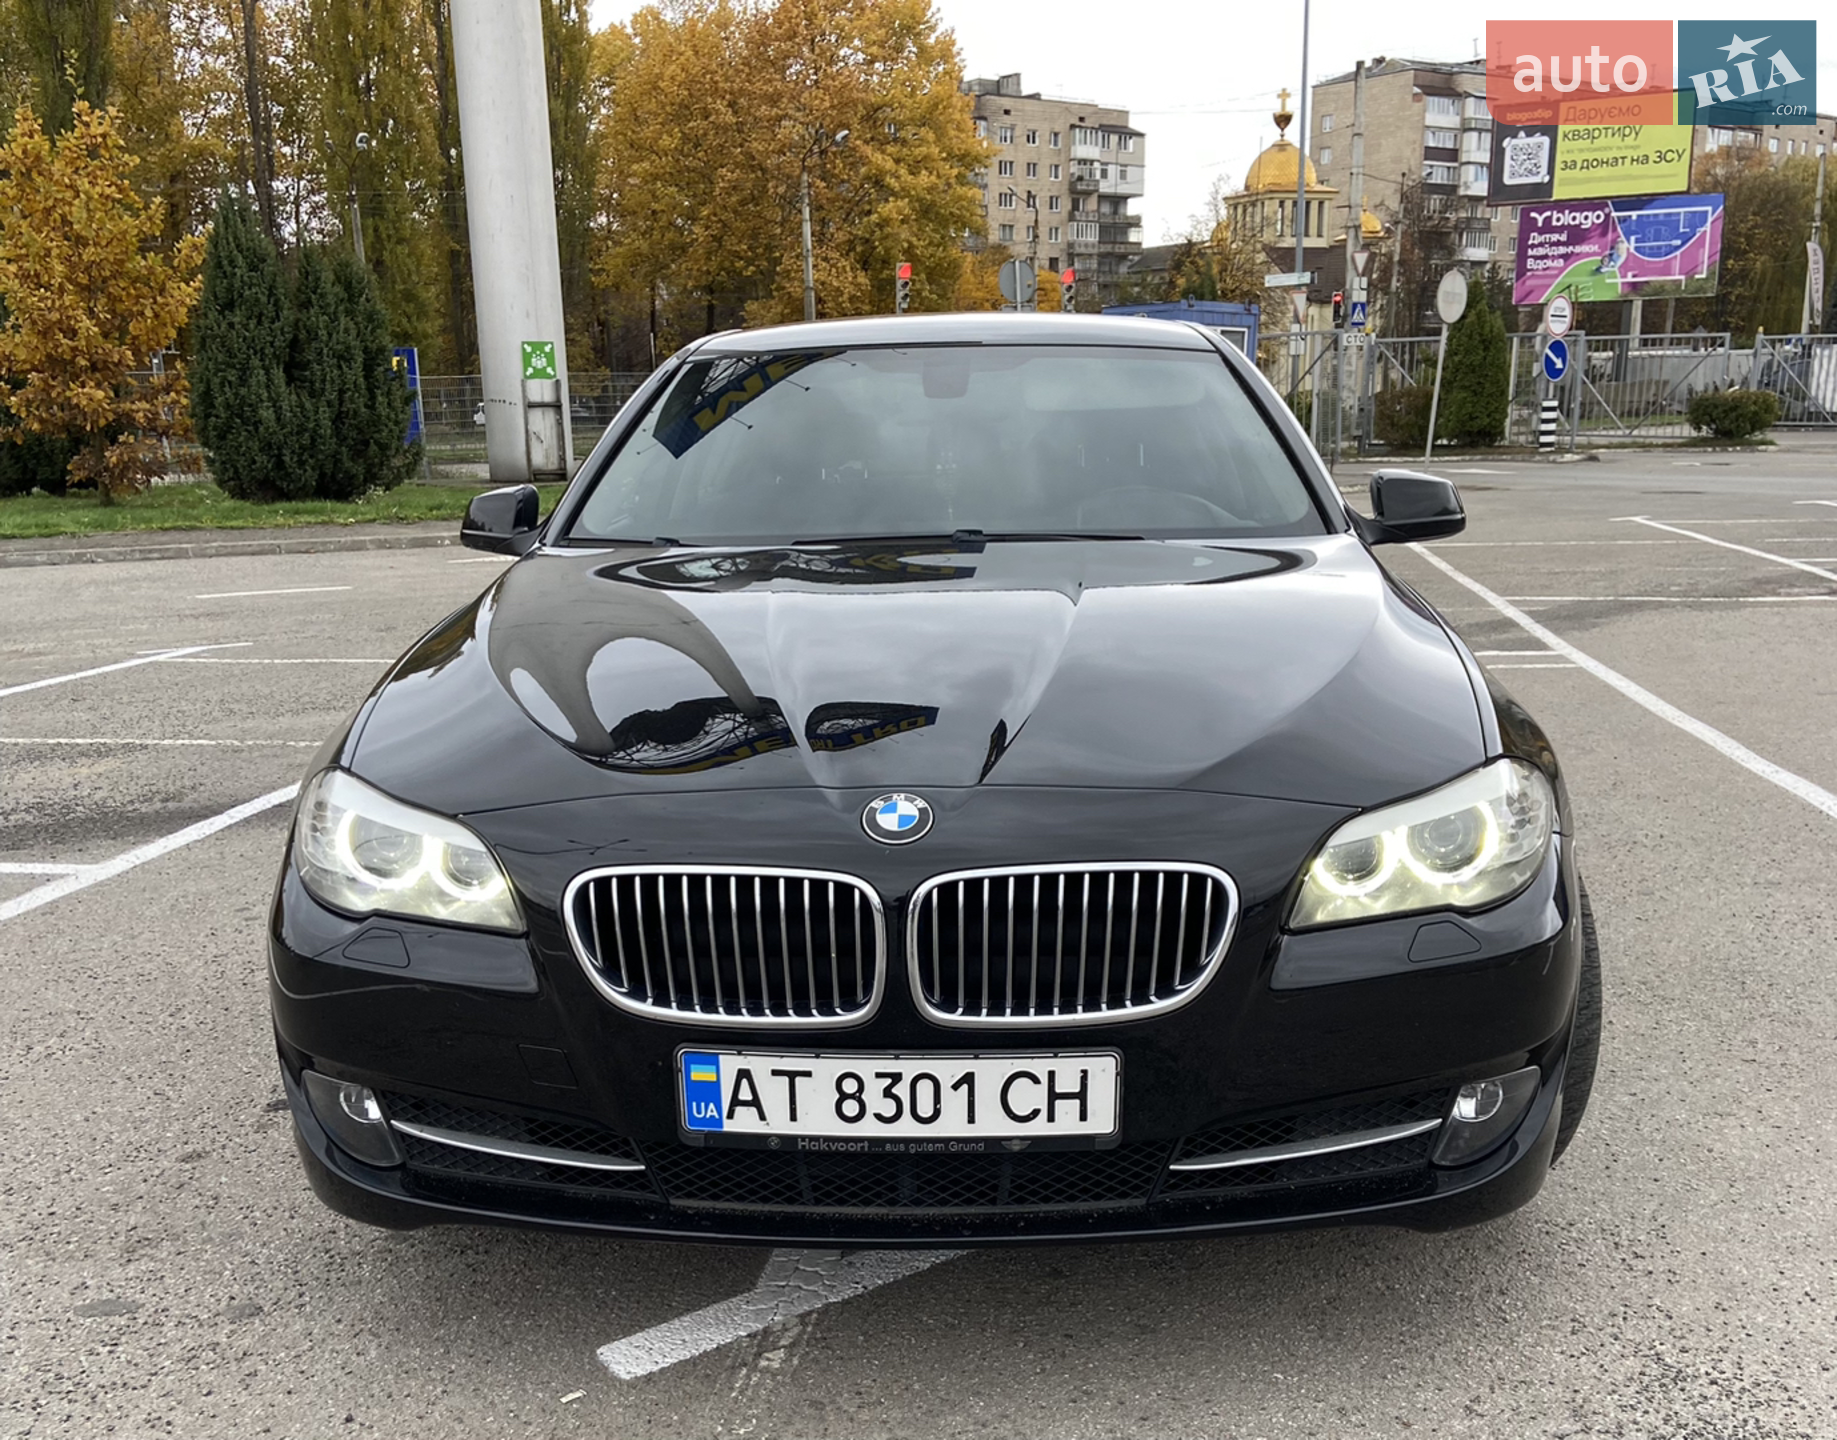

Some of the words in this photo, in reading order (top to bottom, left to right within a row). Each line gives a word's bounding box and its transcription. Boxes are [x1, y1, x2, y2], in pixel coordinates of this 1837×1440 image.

[1563, 104, 1642, 124] Даруємо
[1562, 124, 1643, 144] квартиру
[1560, 160, 1577, 171] за
[1579, 155, 1628, 171] донат
[1630, 154, 1650, 166] на
[1652, 148, 1686, 164] ЗСУ
[1551, 210, 1605, 229] blago
[1528, 230, 1567, 245] Дитячі
[1526, 258, 1564, 270] Вдома
[725, 1068, 813, 1122] AT
[834, 1070, 976, 1124] 8301
[999, 1069, 1088, 1123] CH
[693, 1101, 719, 1119] UA
[797, 1138, 869, 1151] Hakvoort
[885, 1142, 905, 1151] aus
[909, 1142, 945, 1154] gutem
[949, 1140, 984, 1151] Grund
